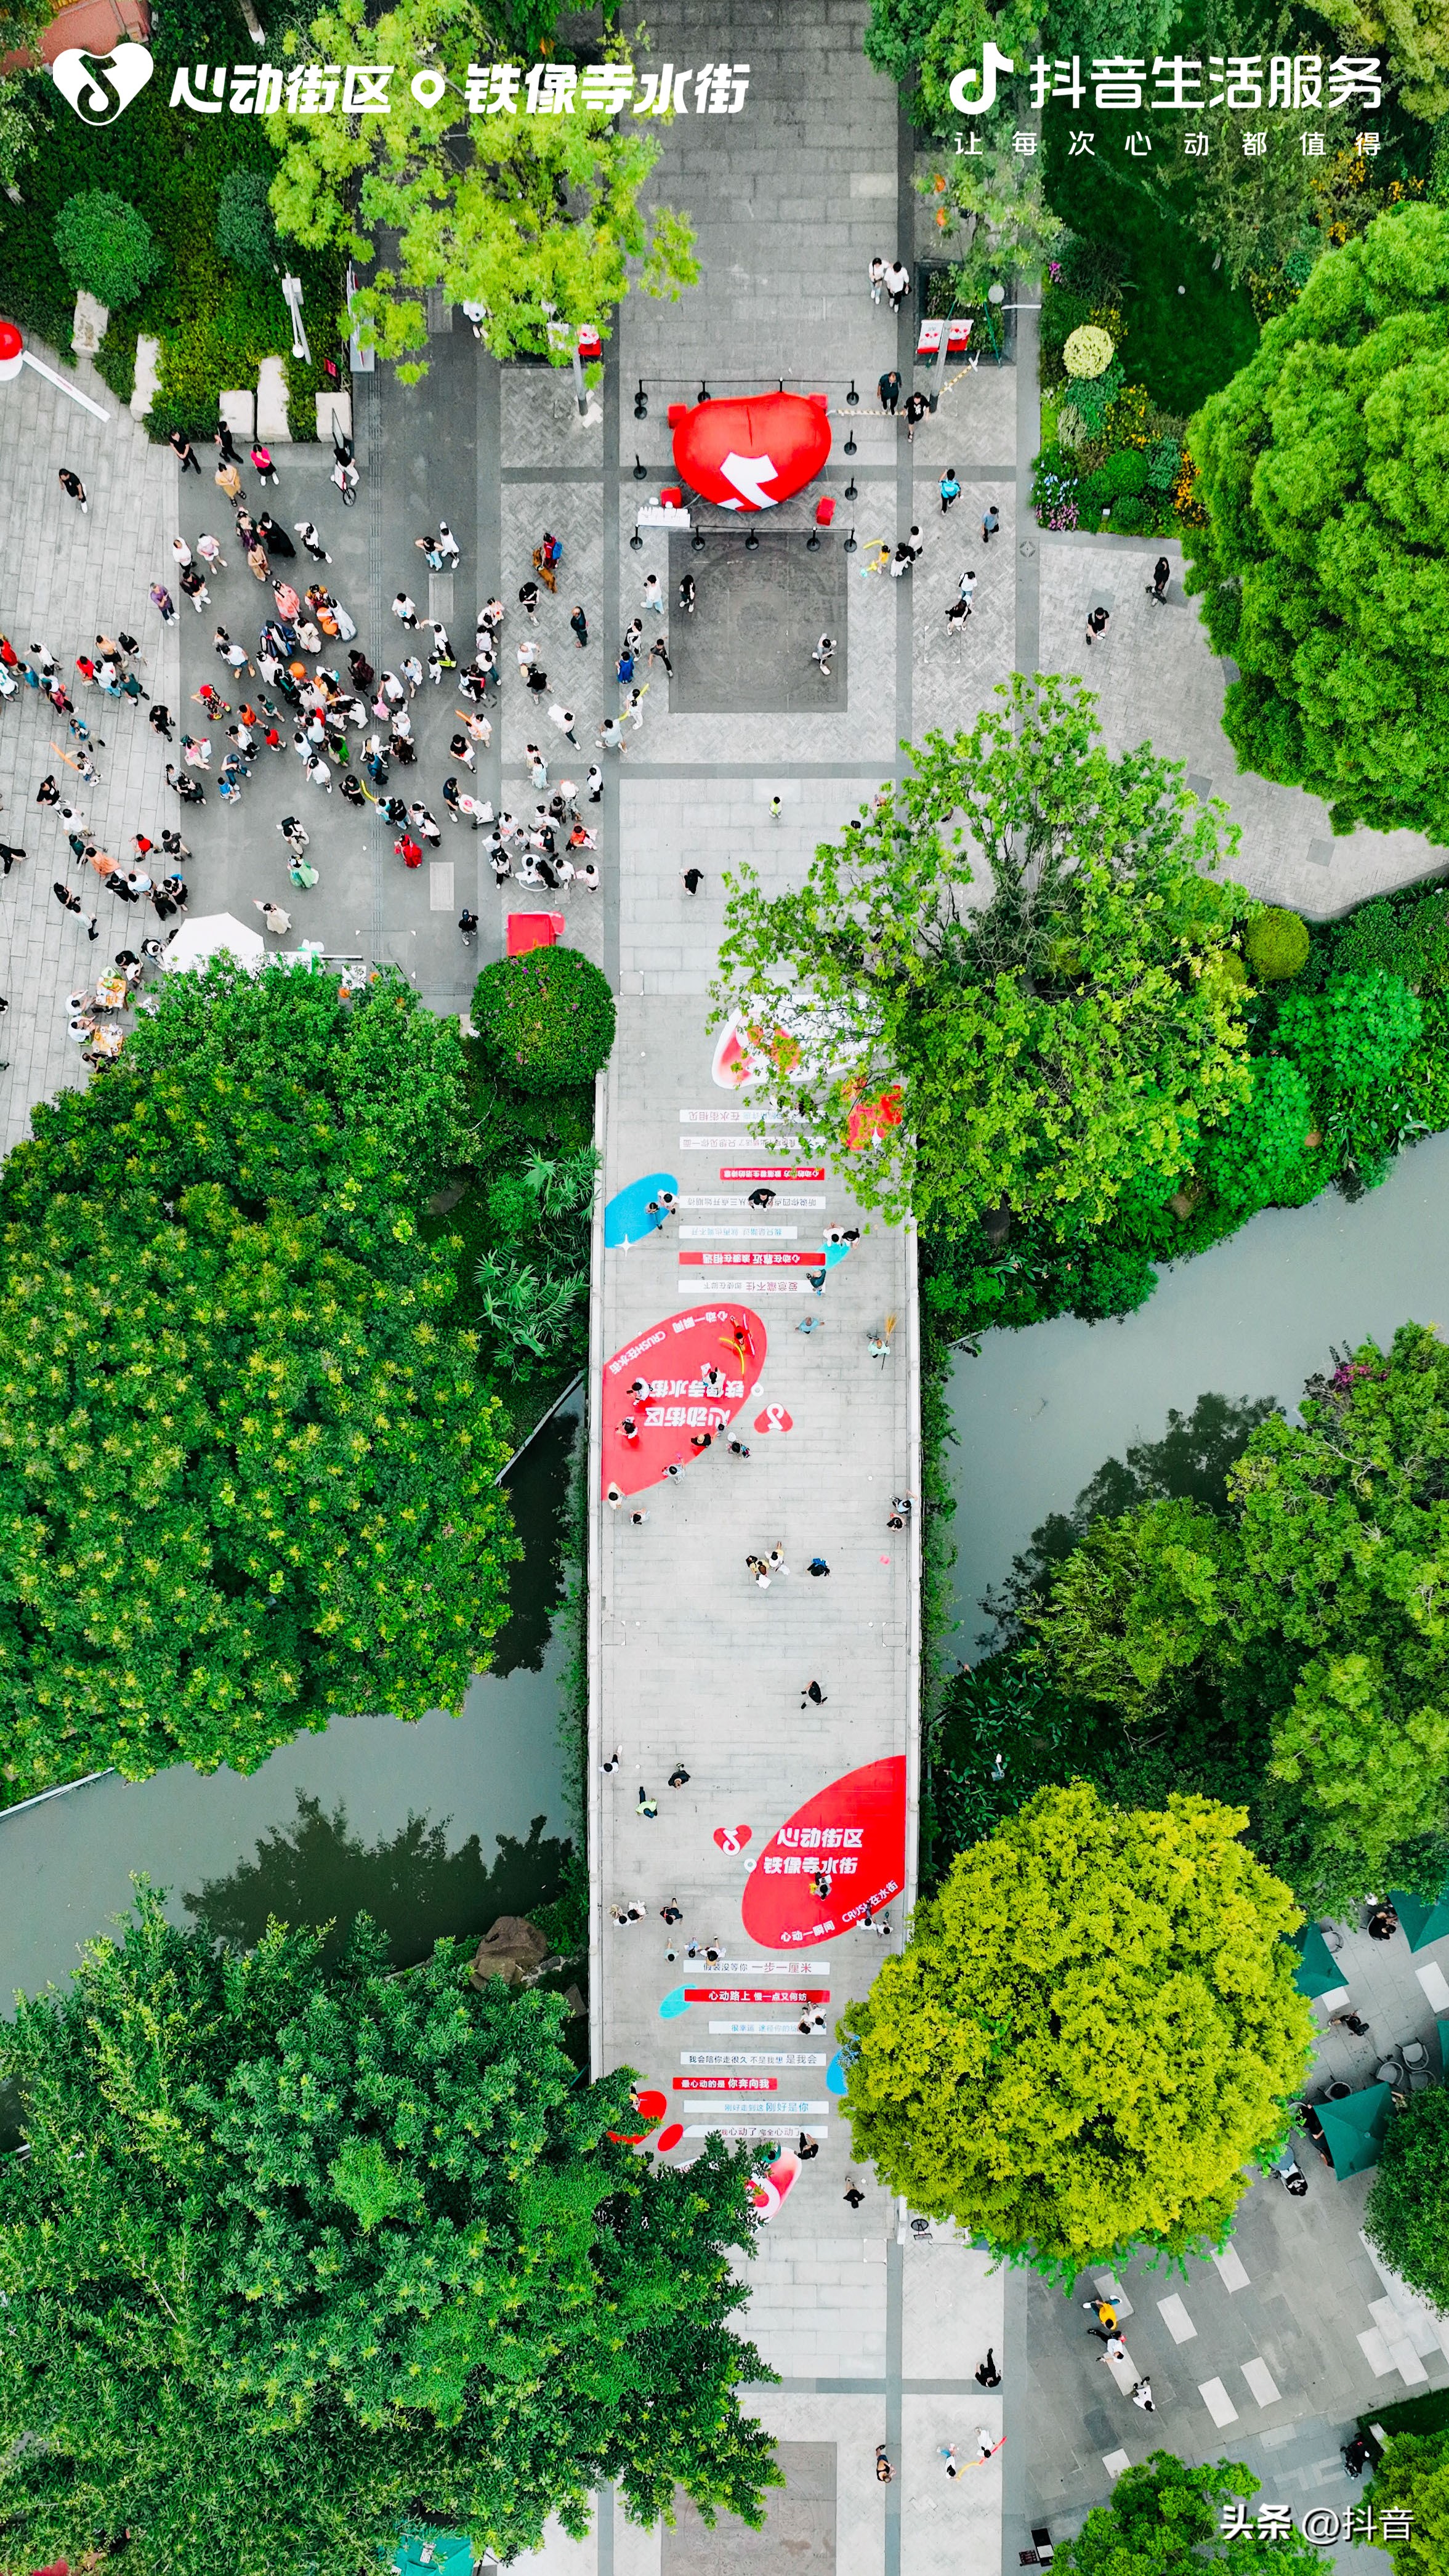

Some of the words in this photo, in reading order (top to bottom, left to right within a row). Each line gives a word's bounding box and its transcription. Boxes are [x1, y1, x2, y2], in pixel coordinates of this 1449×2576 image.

[783, 1170, 820, 1178] 心动的方
[702, 1253, 750, 1264] 浪漫在相遇
[752, 1253, 800, 1264] 心动在靠近
[608, 1330, 666, 1375] CRUSH在水街
[644, 1407, 730, 1427] 心动街区
[777, 1828, 864, 1849] 心动街区
[763, 1856, 858, 1875] 铁像寺水街
[780, 1920, 836, 1943] 心动一瞬间
[751, 1962, 812, 1974] 一步一厘米
[708, 1990, 751, 2001] 心动路上
[754, 1992, 807, 2001] 慢一点又何妨
[688, 2055, 748, 2064] 我会陪你走很久
[786, 2054, 817, 2064] 是我会
[681, 2078, 725, 2088] 最心动的是
[727, 2078, 770, 2089] 你奔向我
[765, 2102, 809, 2112] 刚好是你
